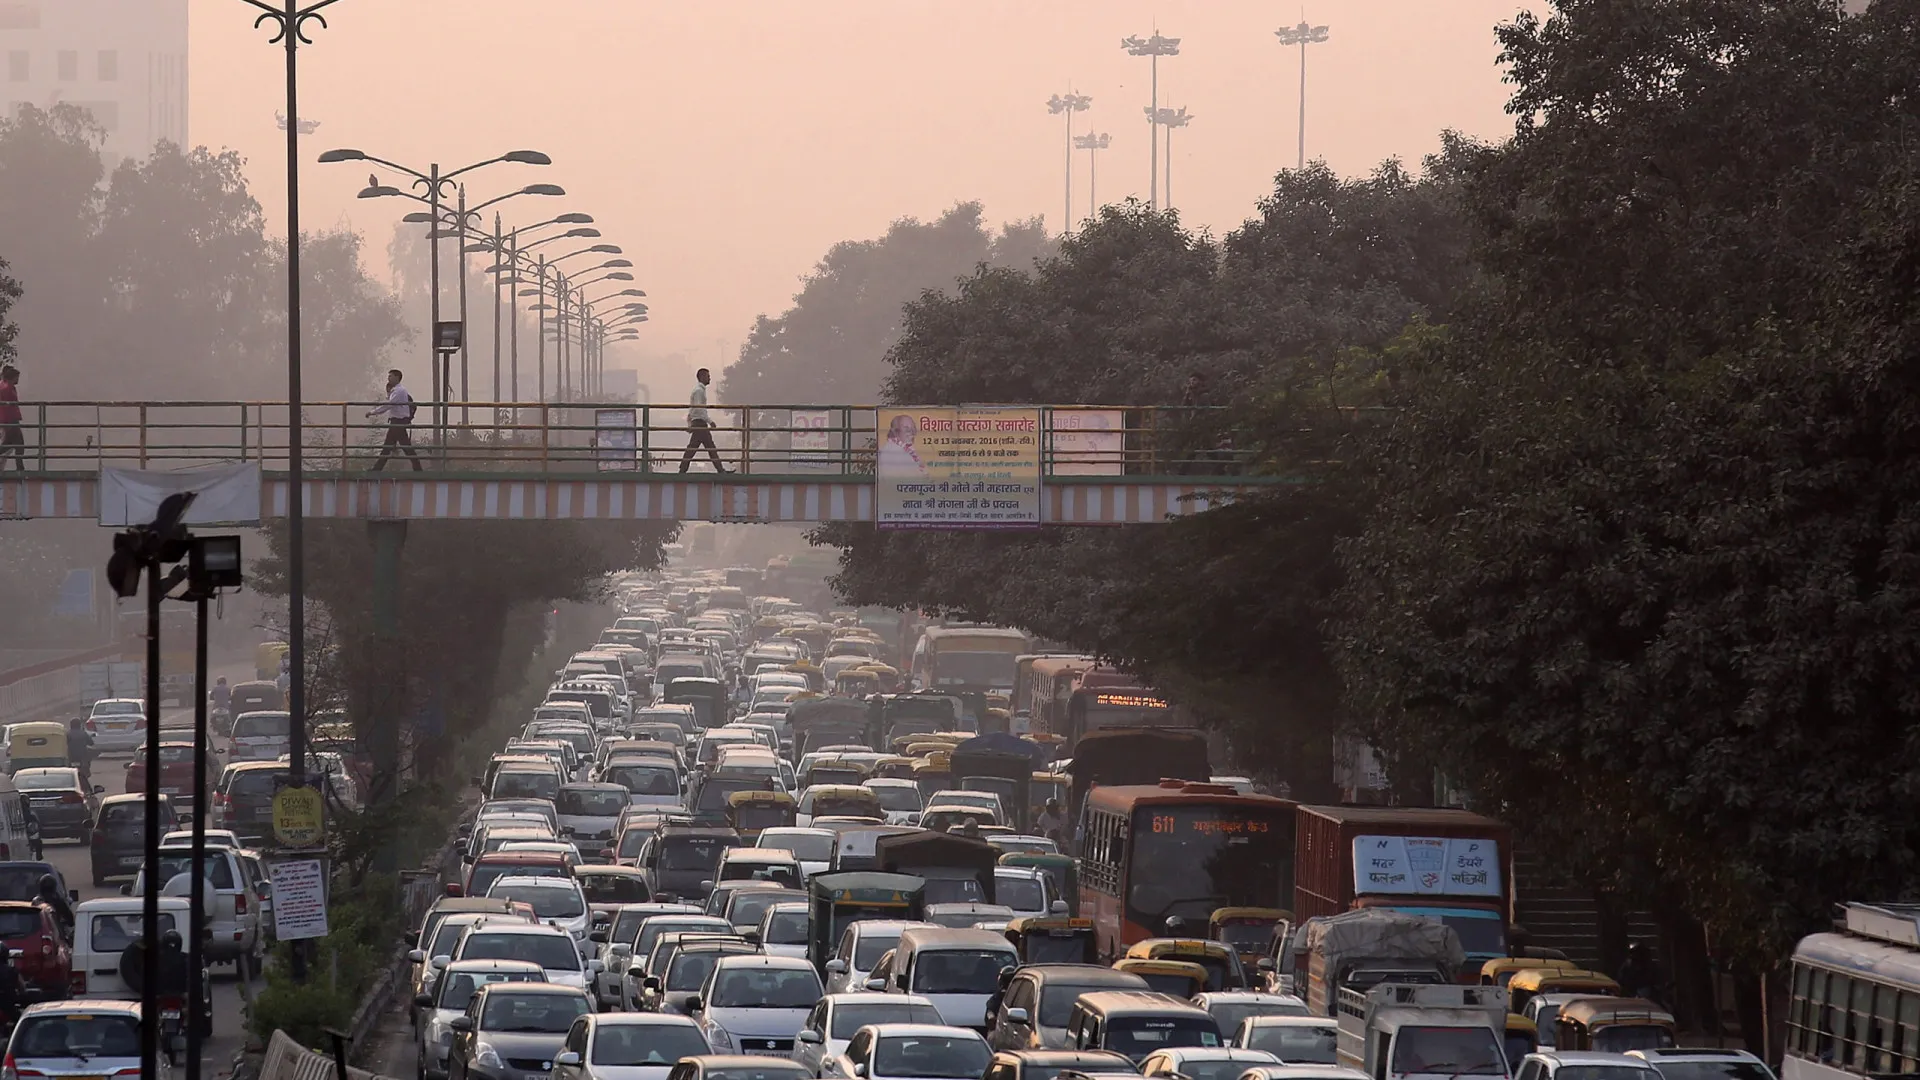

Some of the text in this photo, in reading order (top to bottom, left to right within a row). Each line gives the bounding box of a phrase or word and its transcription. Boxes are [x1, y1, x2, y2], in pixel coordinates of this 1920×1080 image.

[920, 416, 1035, 432] विशाल सत्संग समारोह
[979, 449, 985, 457] से
[993, 449, 1005, 457] बजे
[897, 484, 936, 496] परमपूज्य
[938, 482, 949, 493] श्री
[952, 482, 970, 493] भोले
[973, 482, 984, 493] जी
[987, 484, 1021, 493] महाराज
[903, 498, 1019, 509] माता श्री मंगला जी के प्रवचन
[1153, 816, 1175, 833] 611
[1377, 841, 1388, 849] N
[1469, 844, 1479, 852] P
[1456, 856, 1484, 868] डेयरी
[1368, 872, 1389, 884] फल
